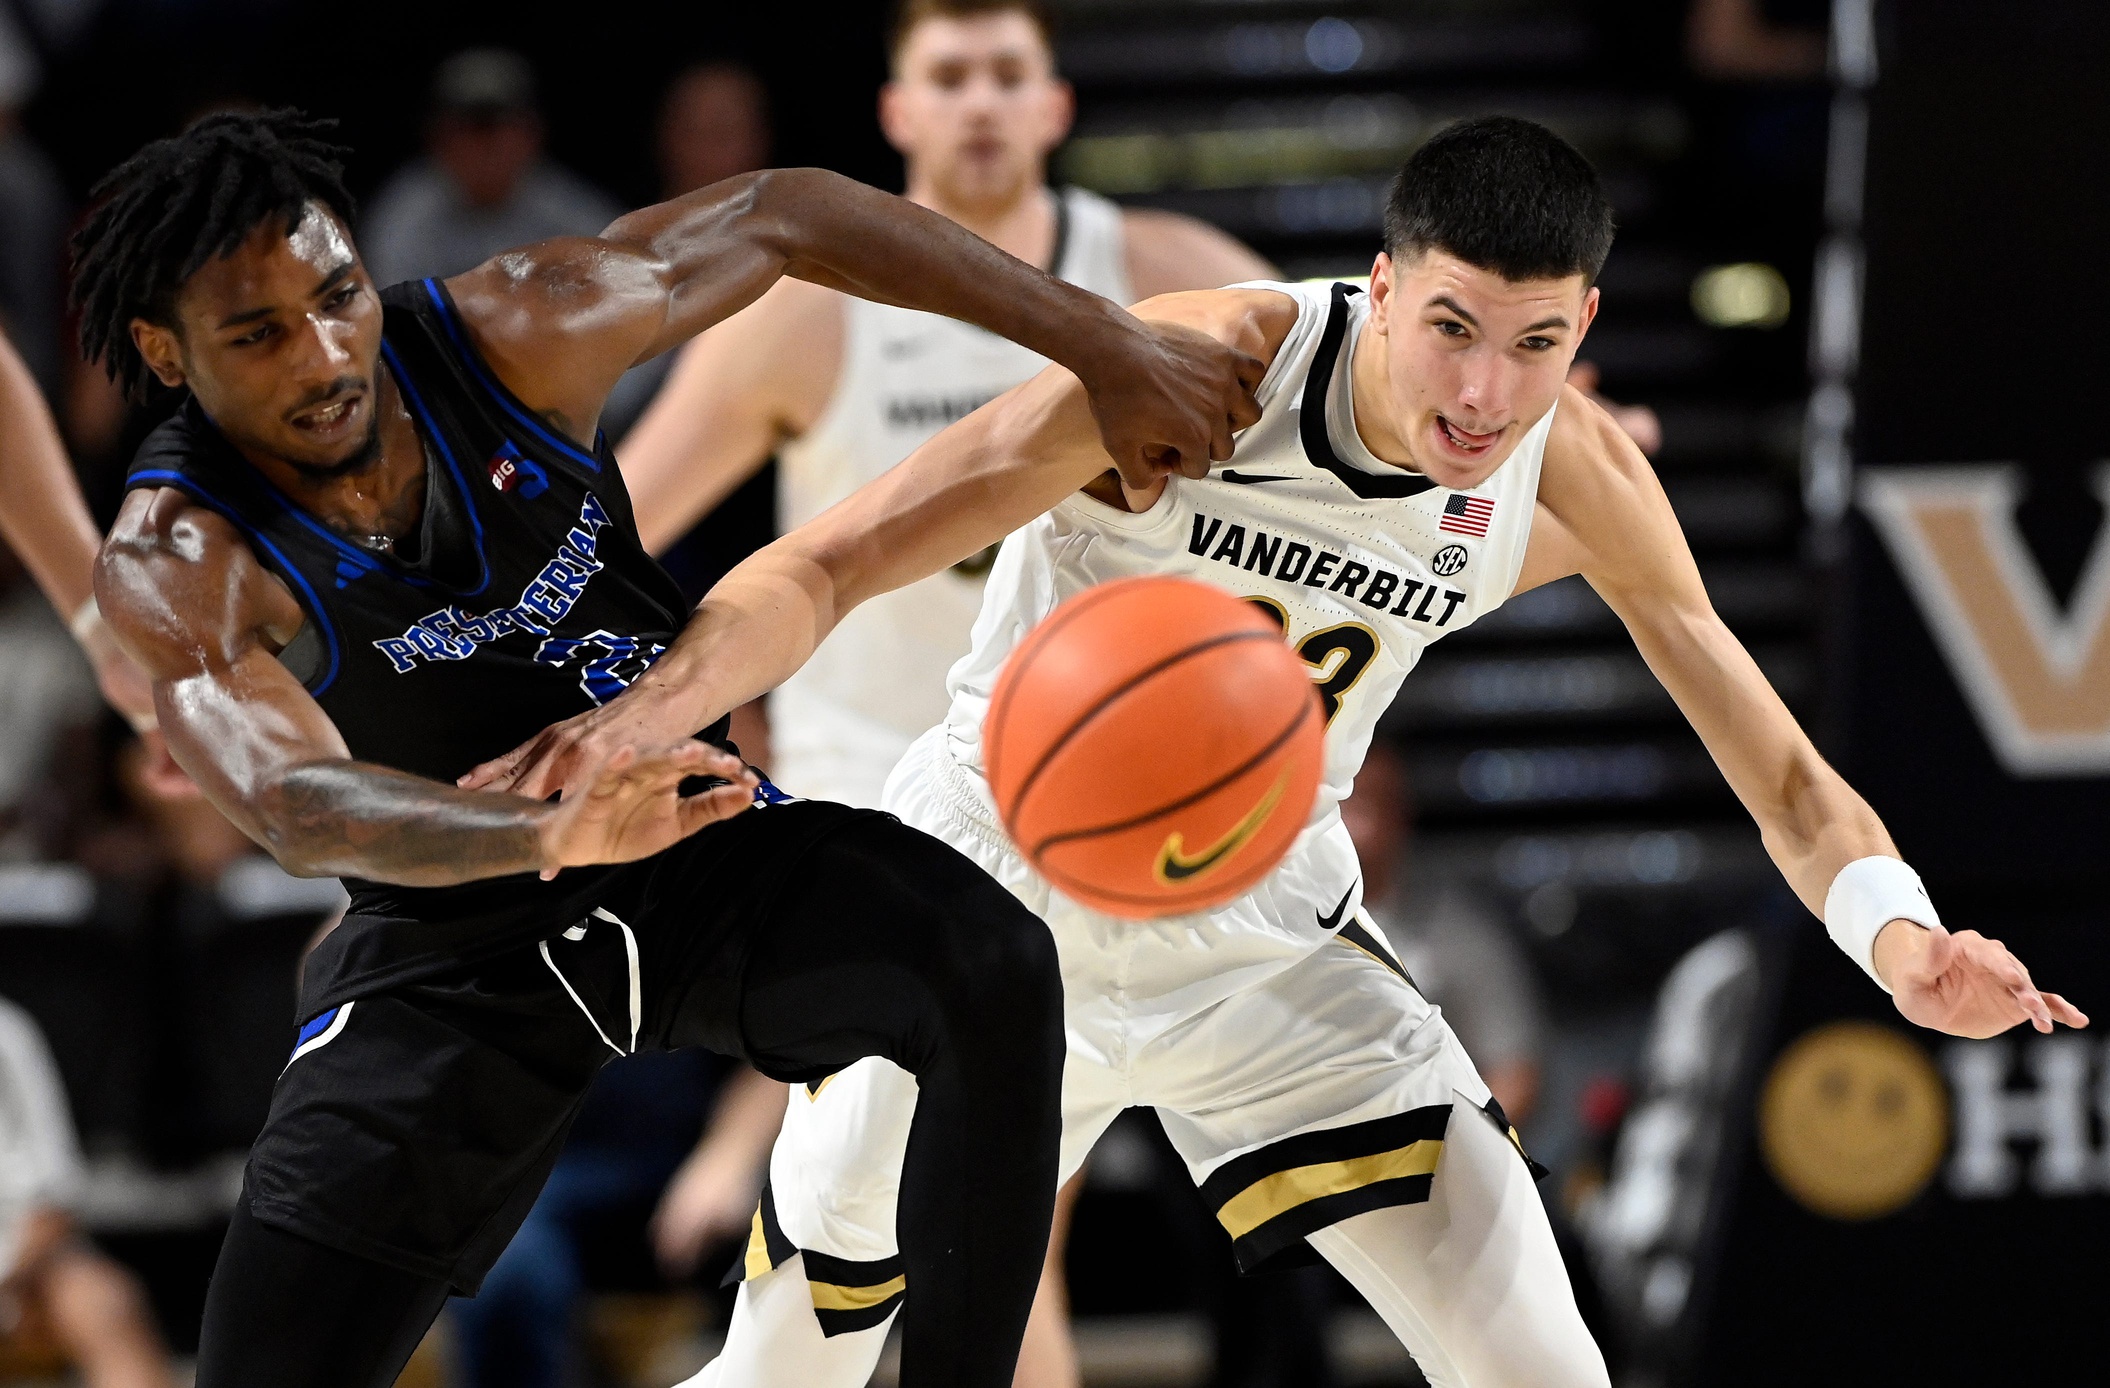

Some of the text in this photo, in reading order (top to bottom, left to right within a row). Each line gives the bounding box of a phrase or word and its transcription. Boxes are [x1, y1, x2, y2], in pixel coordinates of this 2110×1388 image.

[491, 459, 516, 491] BIG
[373, 491, 613, 673] PRESTERIAN
[1188, 512, 1467, 627] VANDERBILT
[1433, 545, 1467, 576] SEC
[533, 629, 666, 707] 2
[1237, 594, 1381, 736] 3
[1857, 464, 2110, 775] V
